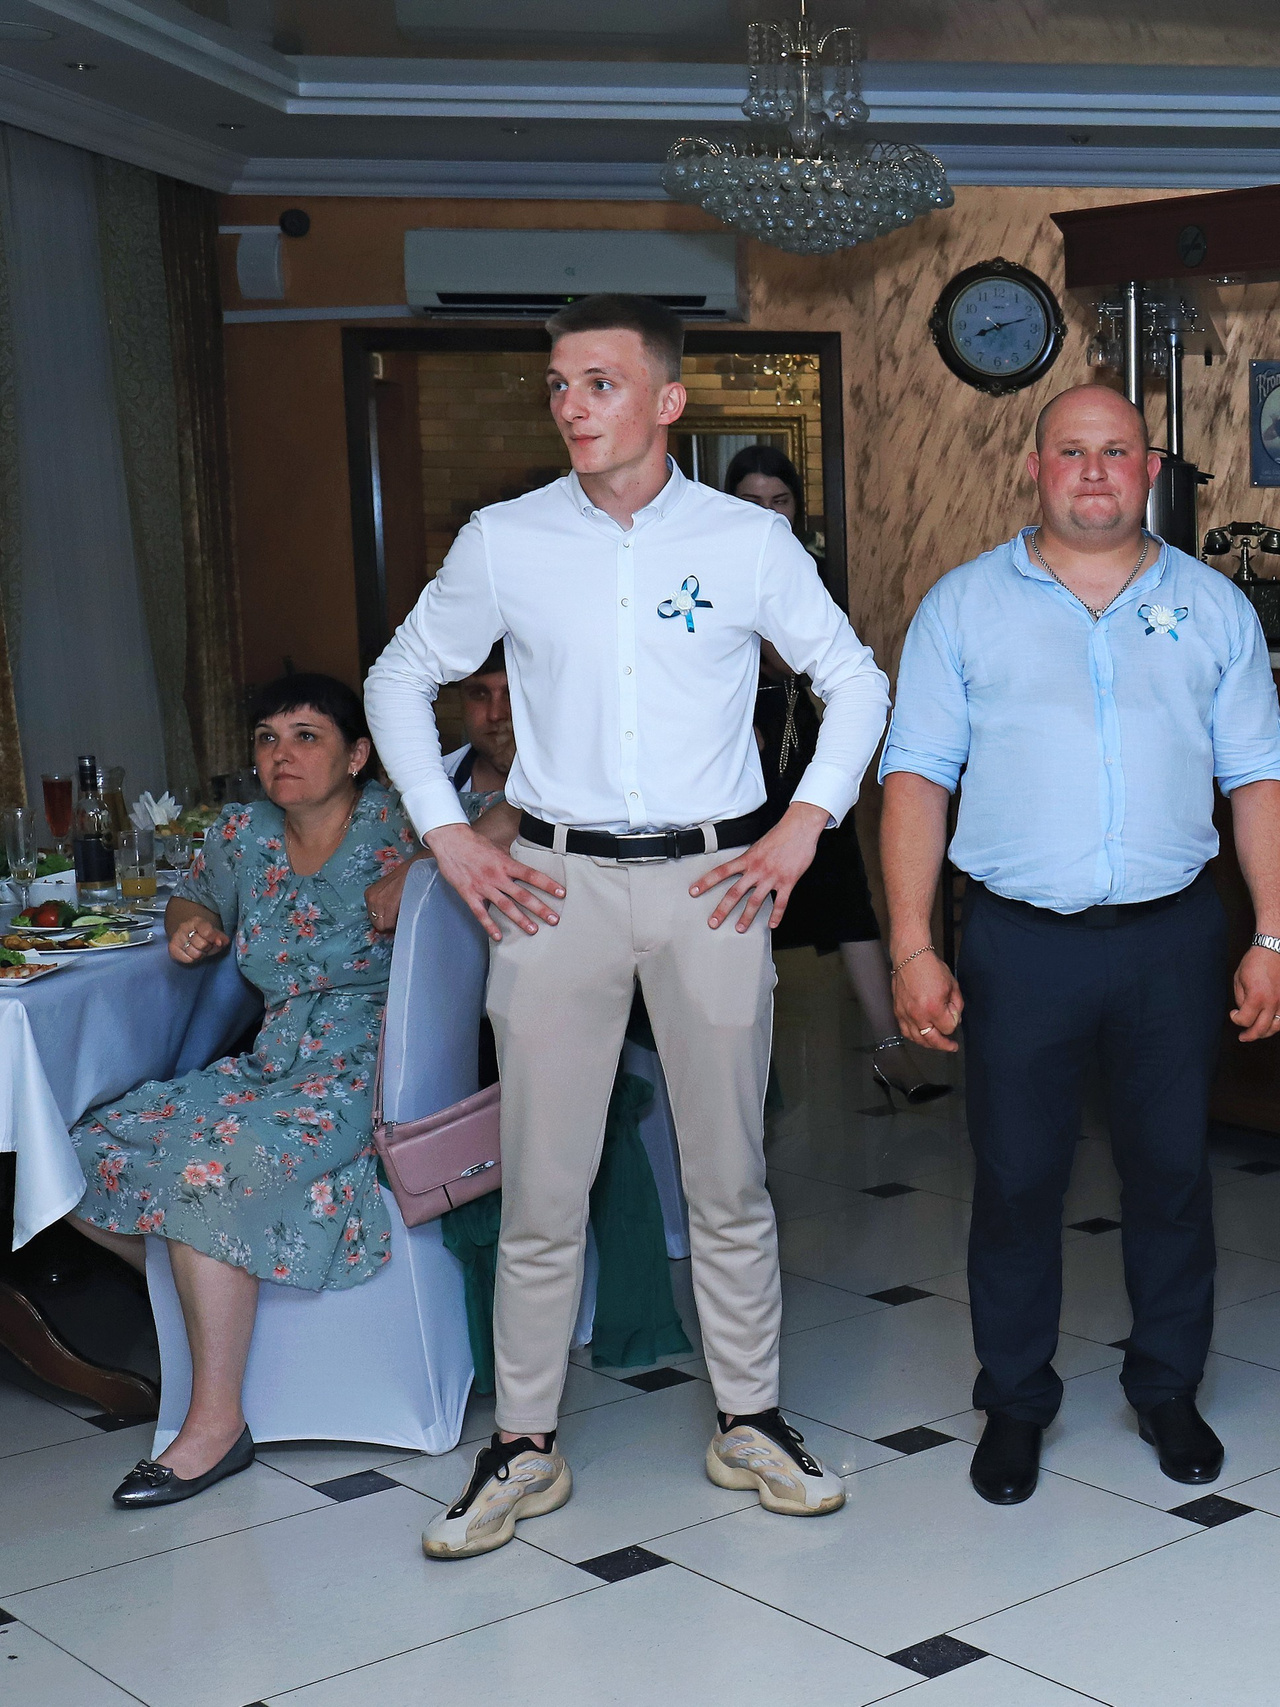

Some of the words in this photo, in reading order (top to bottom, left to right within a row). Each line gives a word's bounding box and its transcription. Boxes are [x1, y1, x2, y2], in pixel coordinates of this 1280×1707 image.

[978, 292, 988, 302] 11
[993, 287, 1006, 298] 12
[1015, 294, 1019, 303] 1
[966, 303, 977, 314] 10
[1025, 306, 1032, 316] 2
[959, 320, 967, 330] 9
[1029, 323, 1038, 334] 3
[964, 336, 972, 346] 8
[1023, 339, 1031, 350] 4
[977, 353, 984, 362] 7
[994, 357, 1001, 366] 6
[1012, 353, 1019, 363] 5
